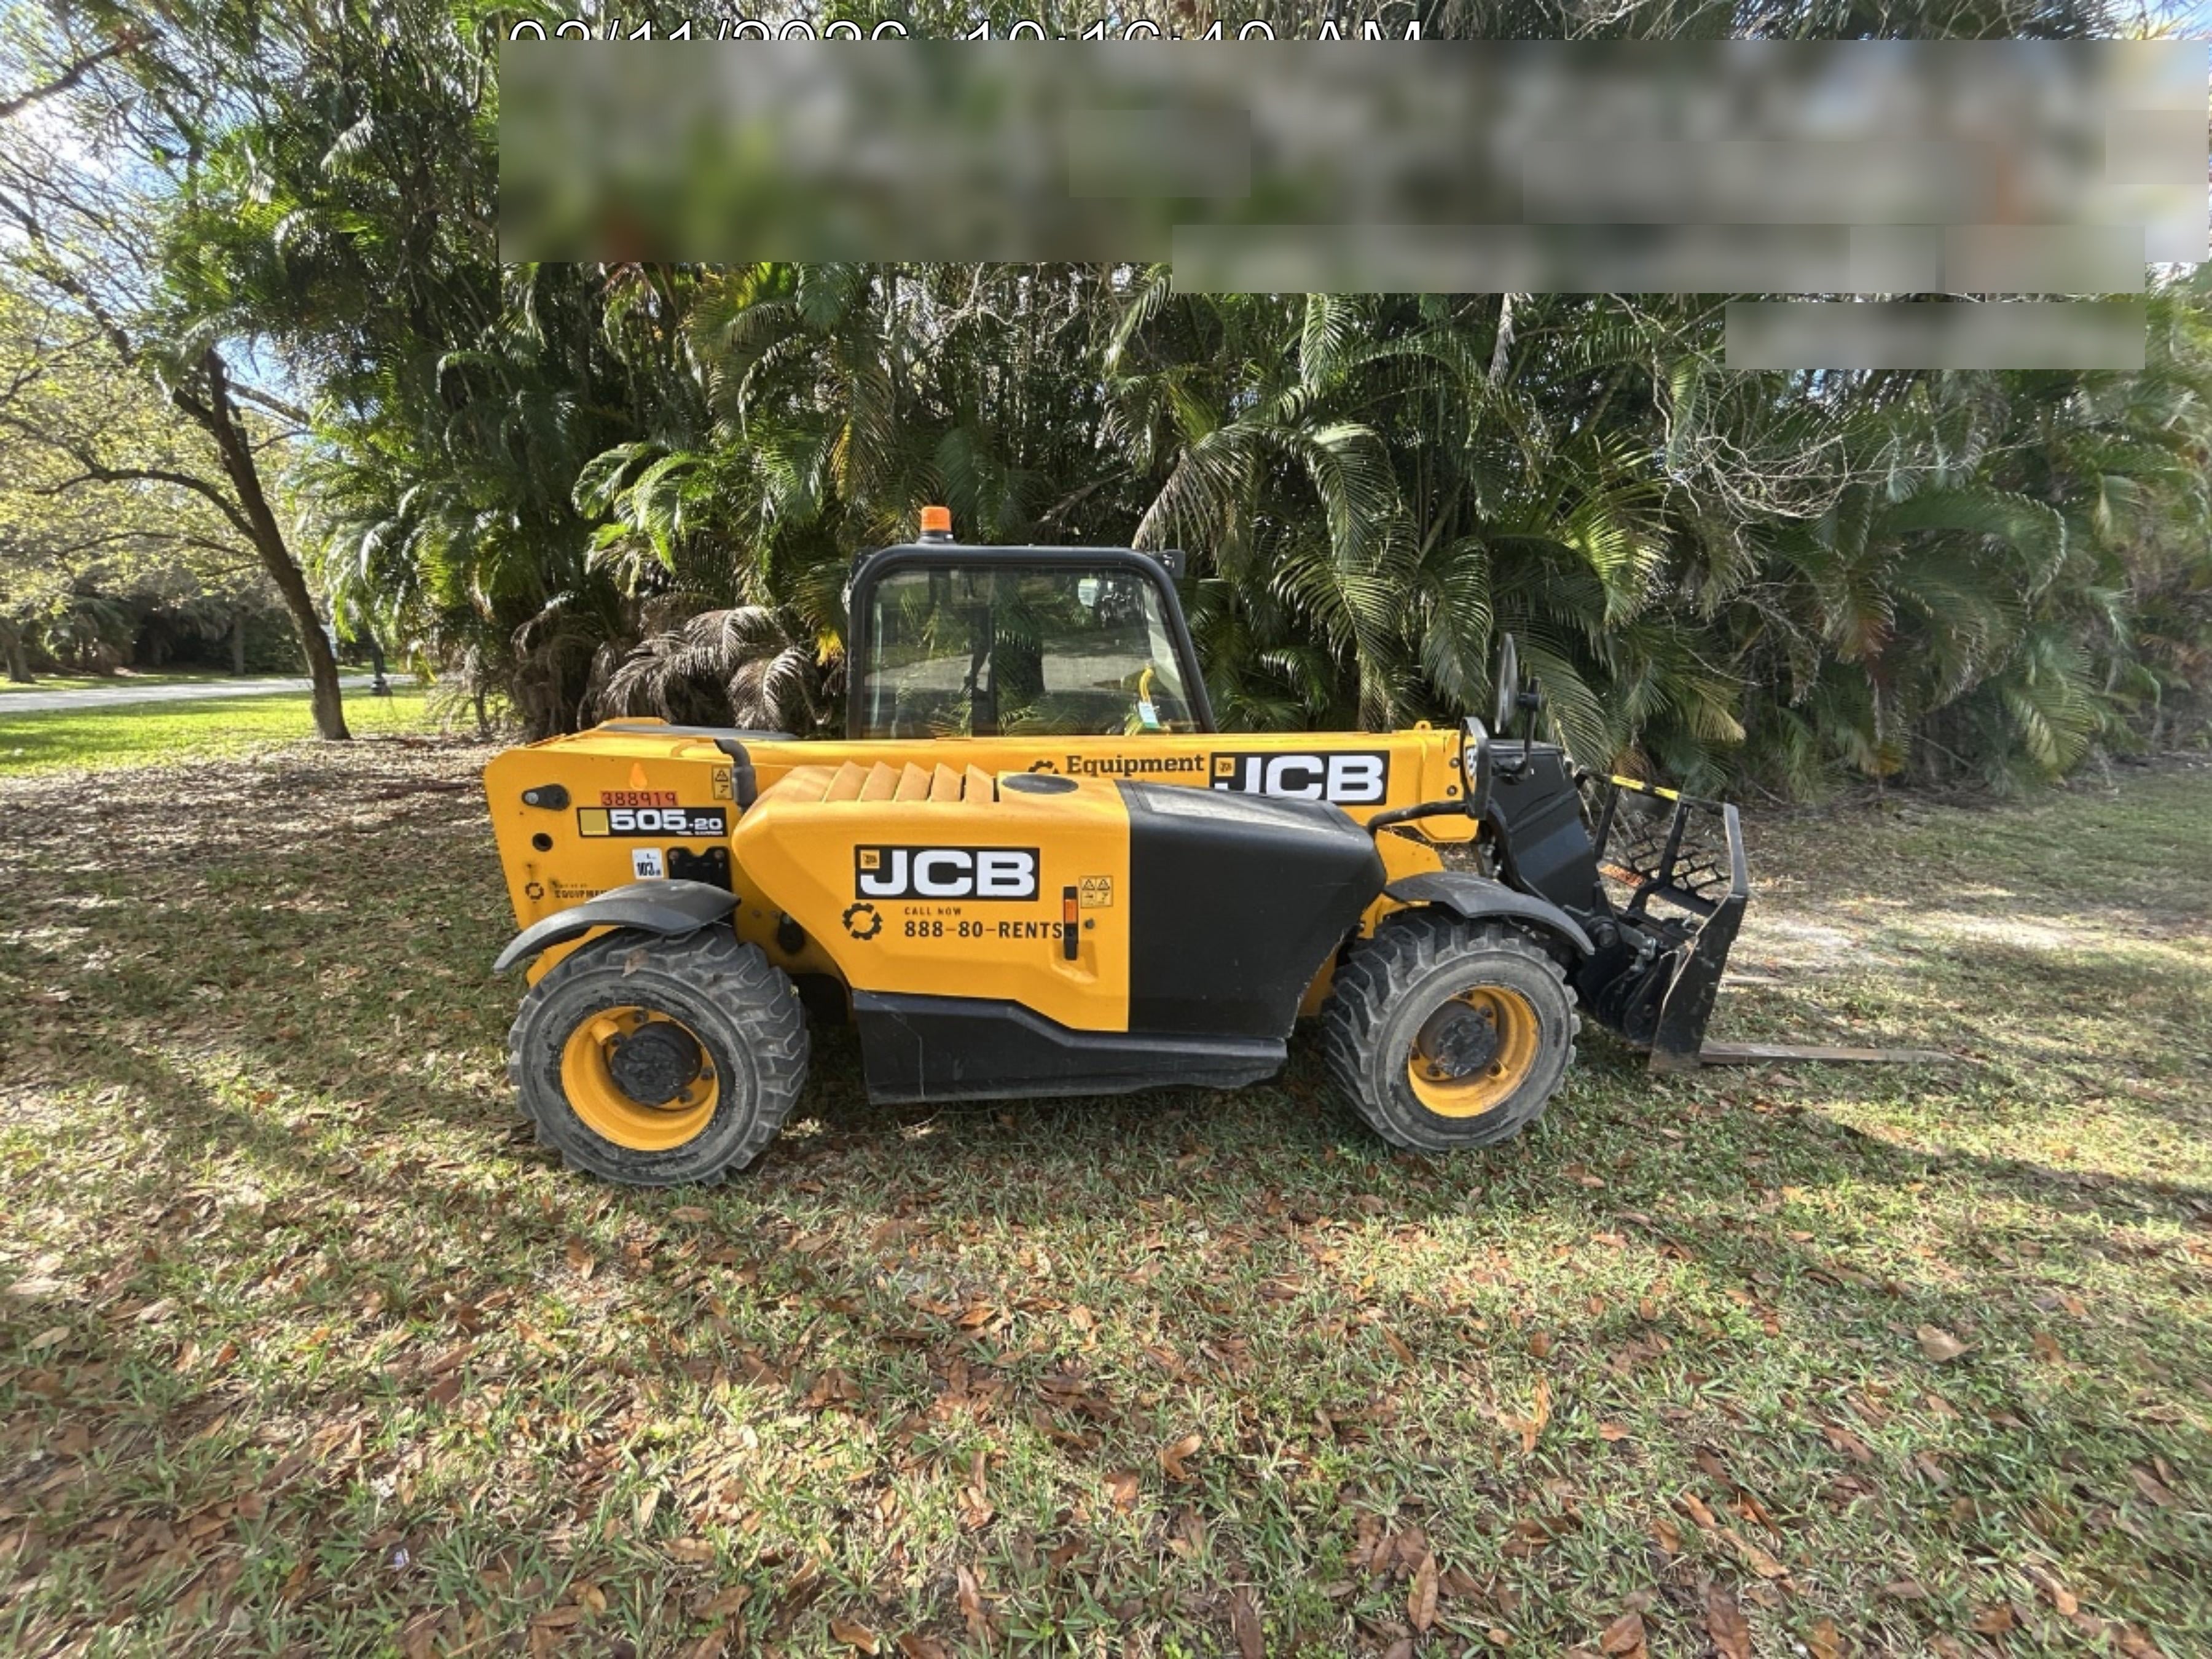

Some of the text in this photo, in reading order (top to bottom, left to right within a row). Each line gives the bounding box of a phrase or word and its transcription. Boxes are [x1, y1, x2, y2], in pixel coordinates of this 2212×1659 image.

[1066, 754, 1204, 777] Equipment
[1214, 756, 1384, 801] JCB
[602, 791, 677, 806] 388919
[860, 849, 1035, 897] JCB
[904, 906, 962, 916] CALL NOW
[904, 920, 1063, 939] 888-80-RENTS
